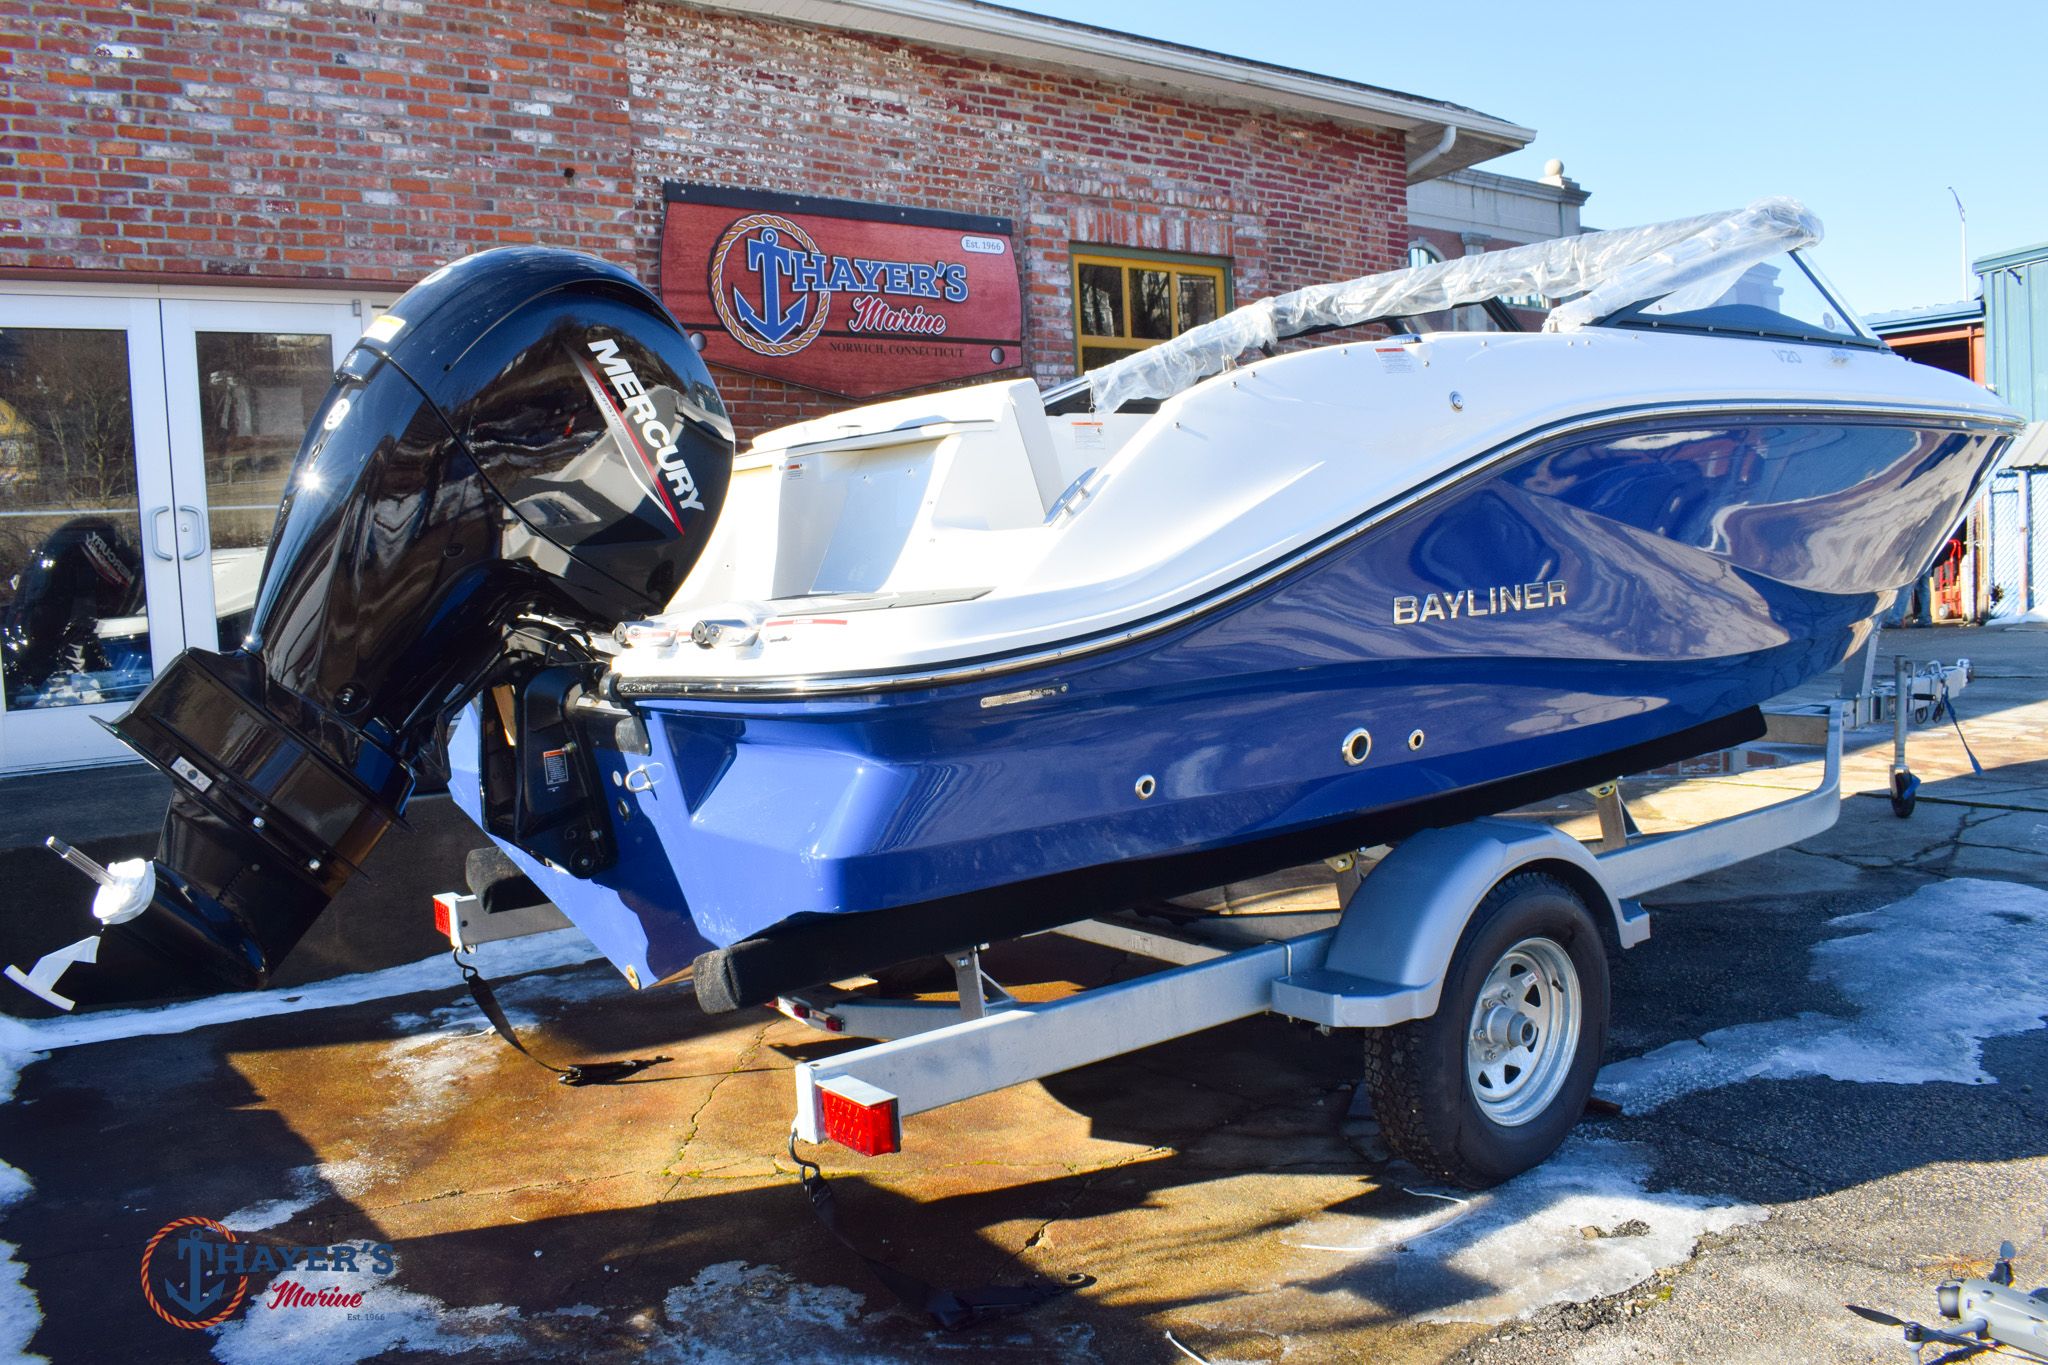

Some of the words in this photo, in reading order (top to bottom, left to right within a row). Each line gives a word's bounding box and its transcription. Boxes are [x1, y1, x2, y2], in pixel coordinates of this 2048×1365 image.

[965, 239, 981, 250] Est.
[982, 241, 1002, 251] 1966
[746, 229, 969, 312] THAYER'S
[849, 295, 947, 335] Marine
[829, 341, 887, 355] NORWICH,
[888, 344, 965, 358] CONNECTICUT
[587, 338, 705, 512] MERCURY
[1392, 579, 1568, 625] BAYLINER
